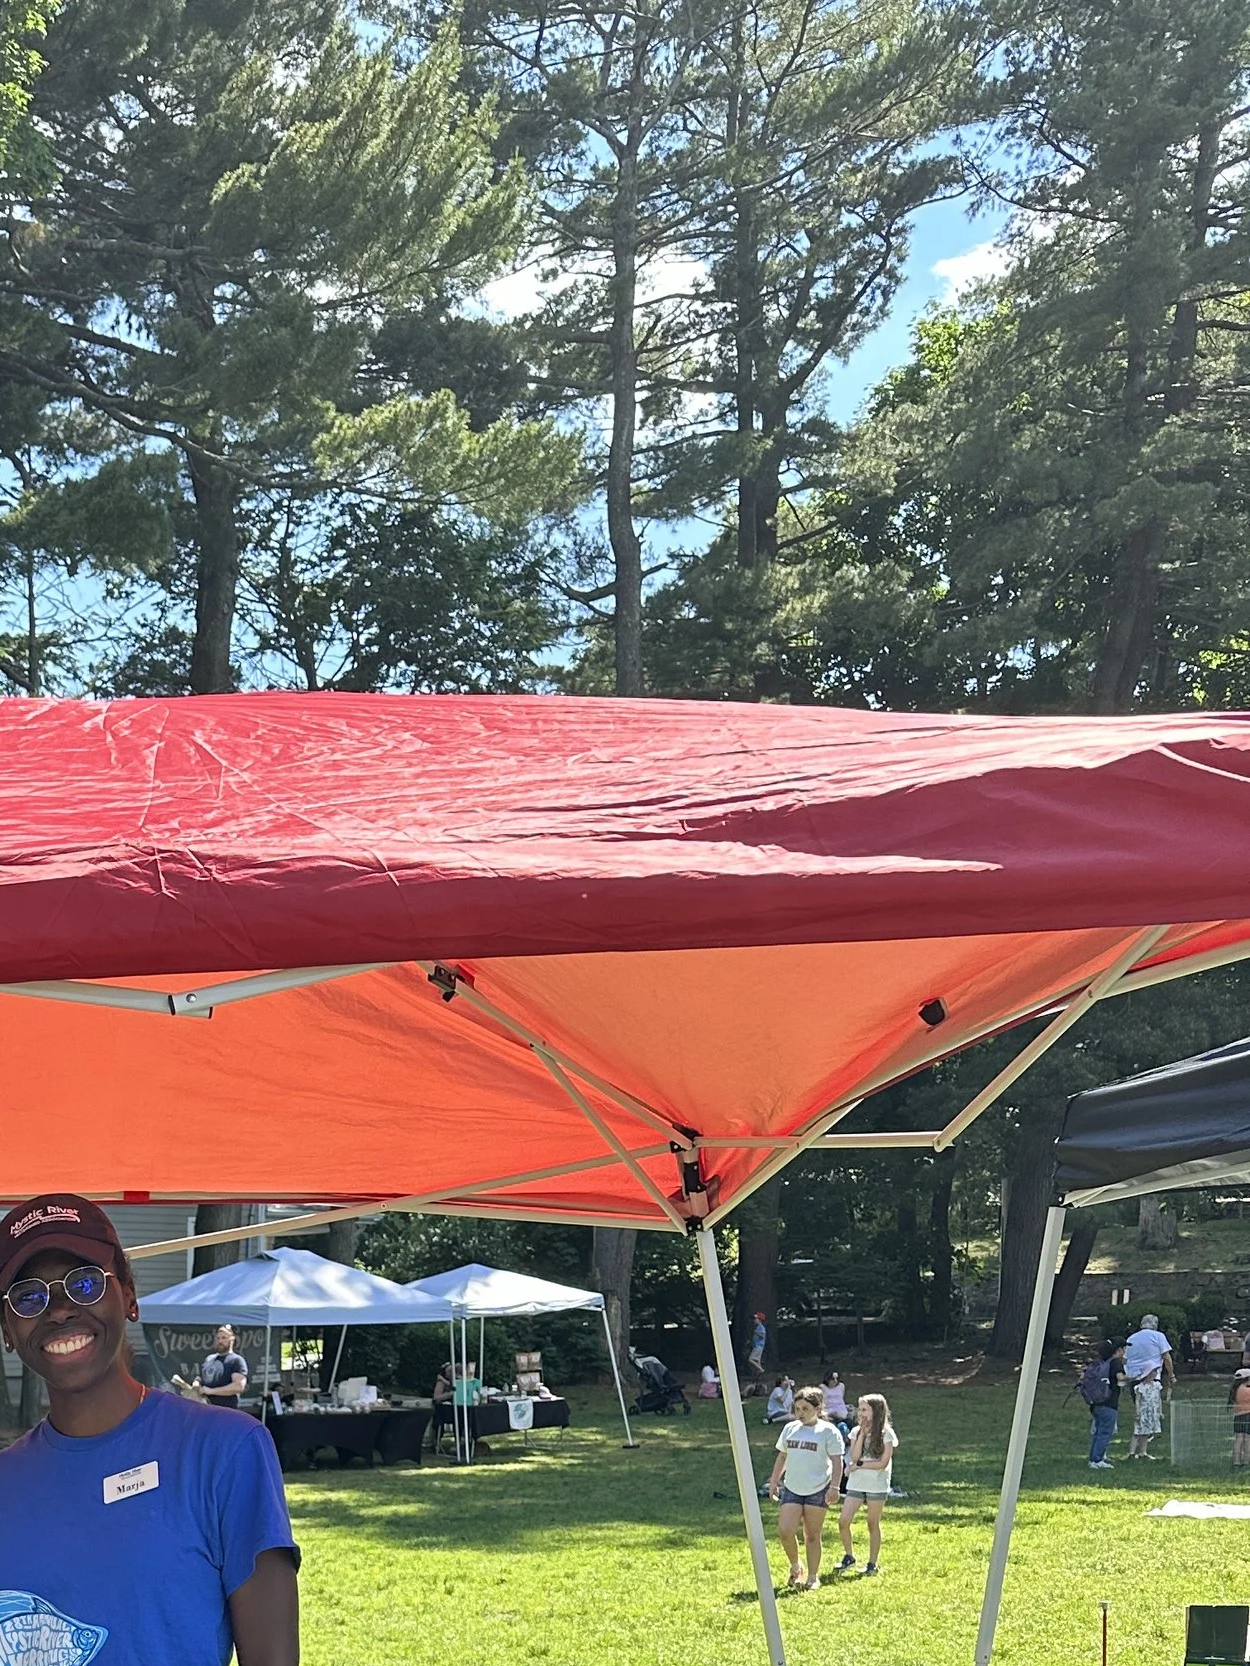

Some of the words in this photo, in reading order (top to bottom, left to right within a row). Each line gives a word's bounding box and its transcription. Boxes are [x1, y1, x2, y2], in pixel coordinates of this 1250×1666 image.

[10, 1209, 44, 1235] Mystic
[47, 1205, 79, 1215] River
[116, 1480, 145, 1496] Marja
